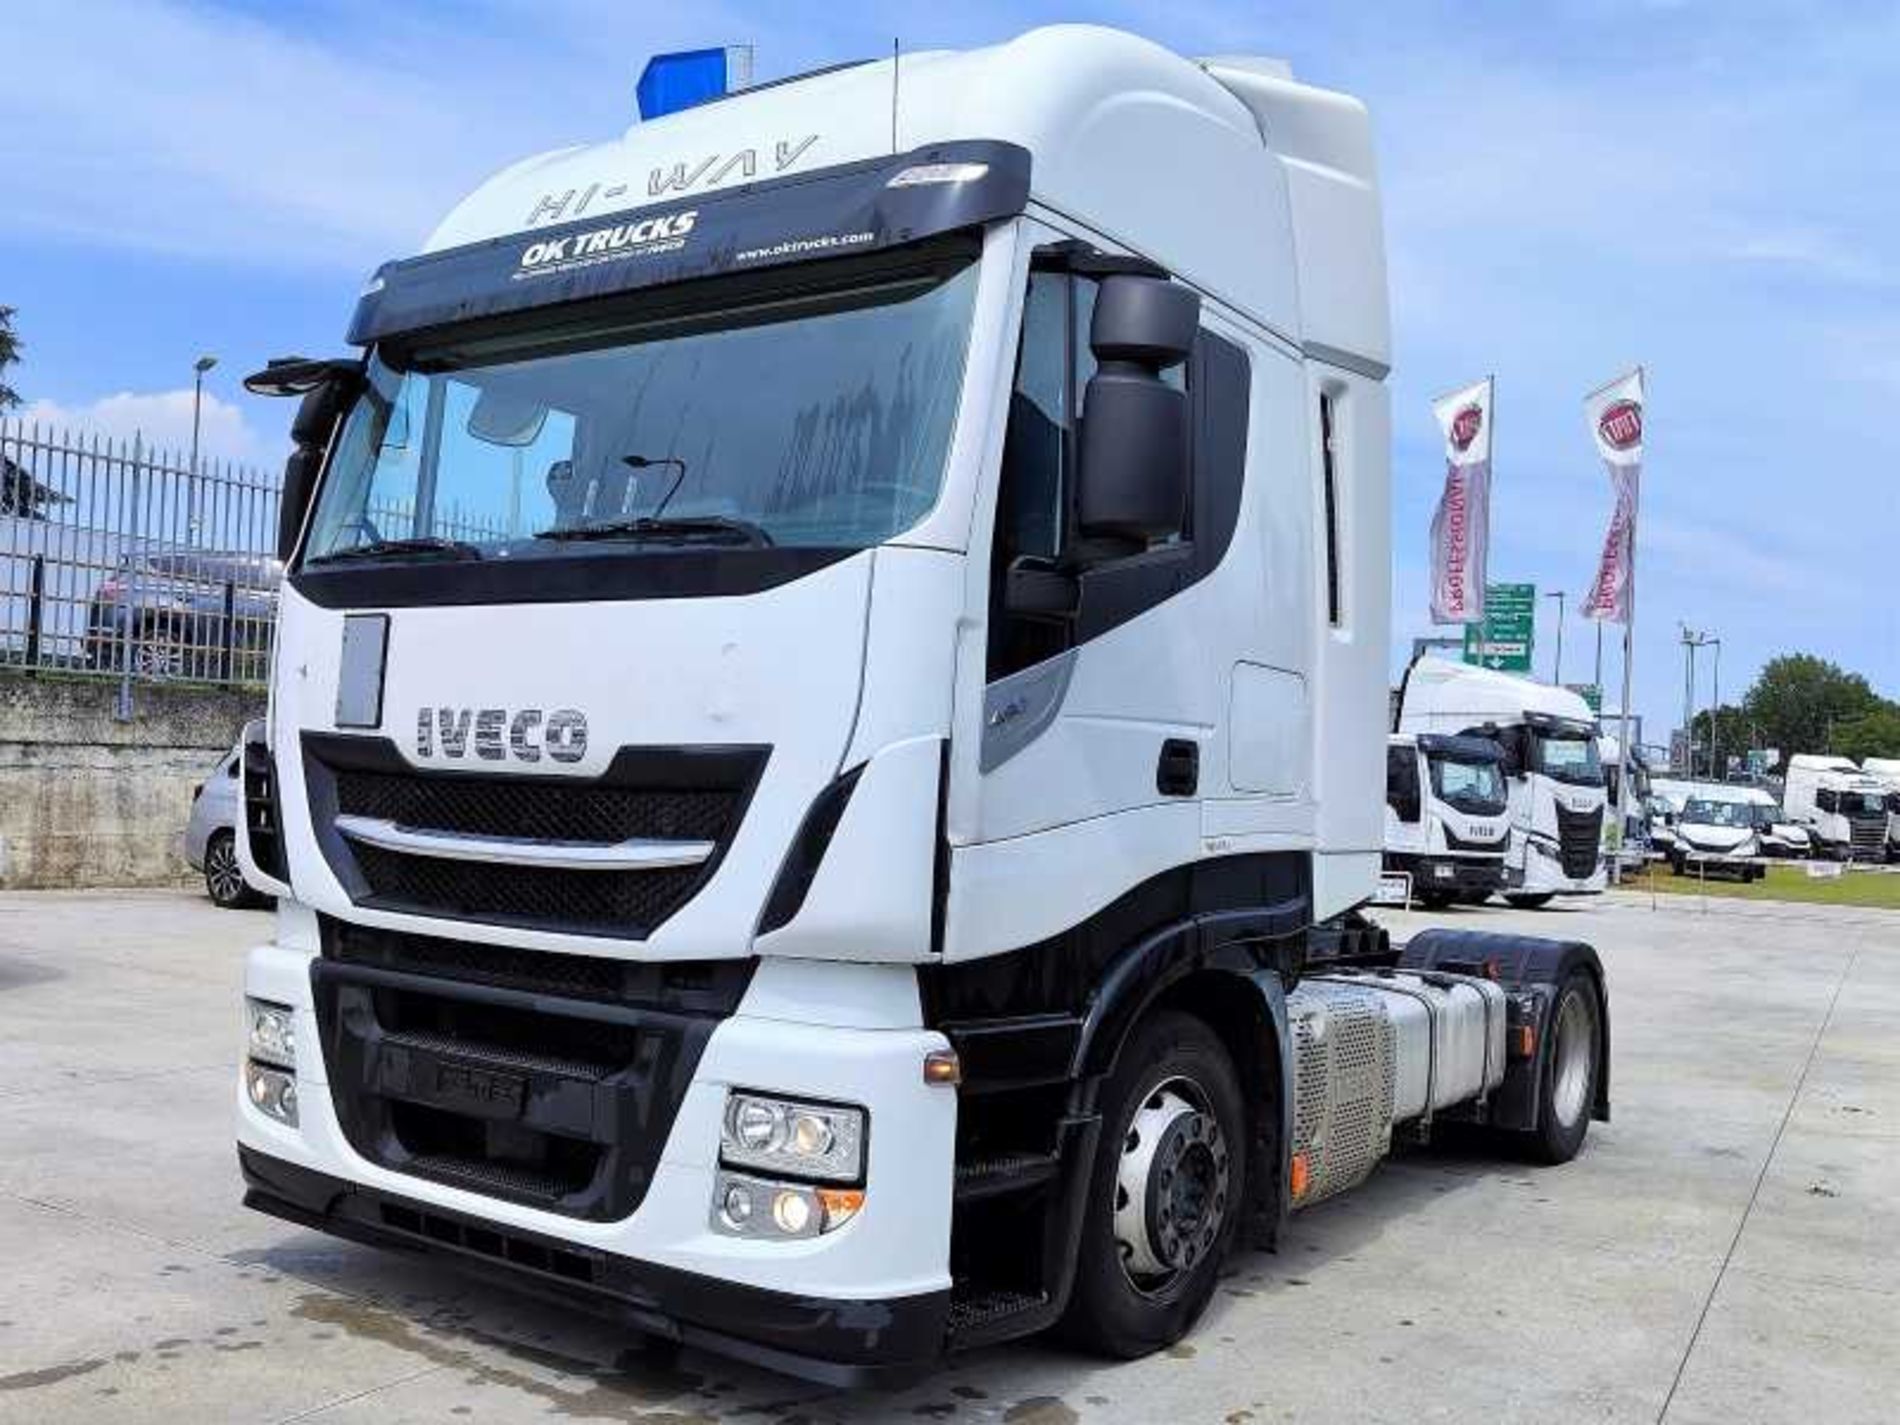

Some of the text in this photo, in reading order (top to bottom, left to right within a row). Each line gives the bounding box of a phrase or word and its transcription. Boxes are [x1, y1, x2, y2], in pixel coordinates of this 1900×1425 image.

[521, 237, 572, 267] OK
[573, 210, 698, 255] TRUCKS
[736, 232, 875, 260] www.oktrucks.com
[417, 707, 588, 763] IVECO
